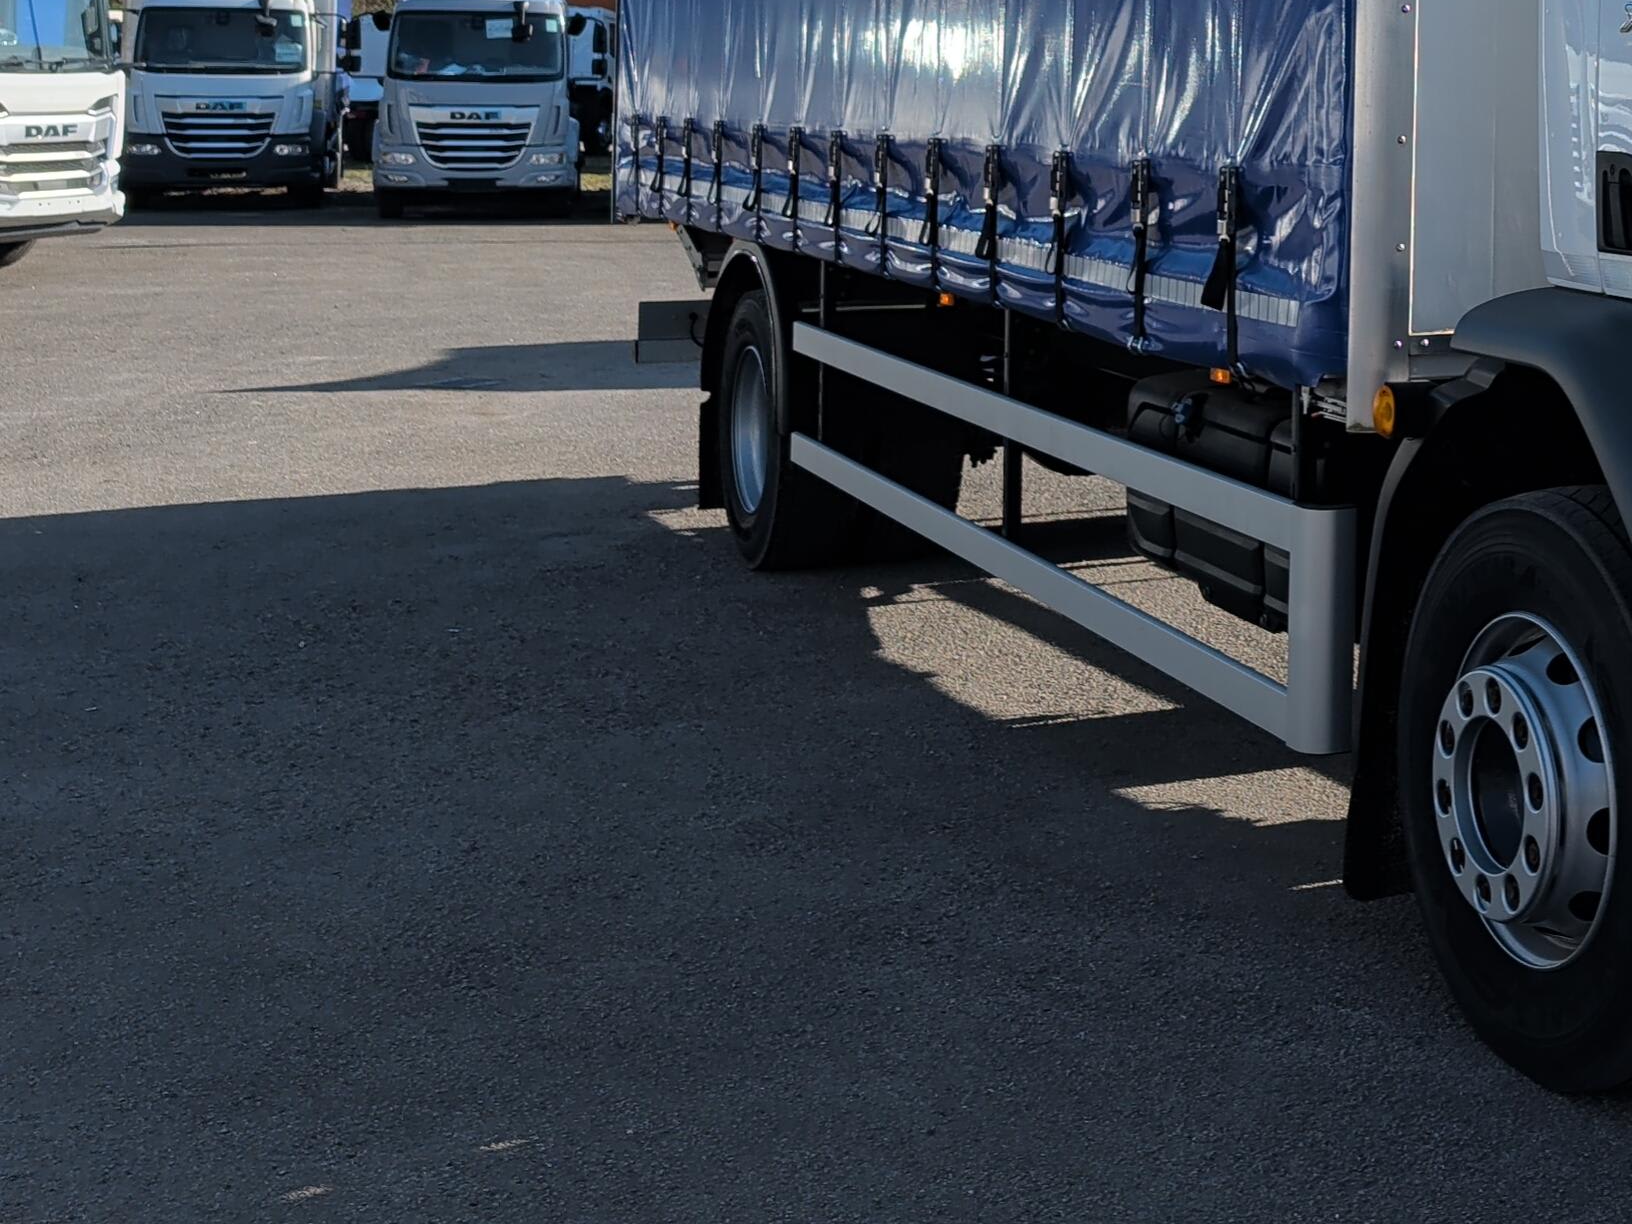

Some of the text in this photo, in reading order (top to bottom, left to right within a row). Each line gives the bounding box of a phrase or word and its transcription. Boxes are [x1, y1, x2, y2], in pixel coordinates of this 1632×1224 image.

[195, 101, 243, 111] DAF
[450, 111, 500, 121] DAF
[25, 123, 78, 138] DAF
